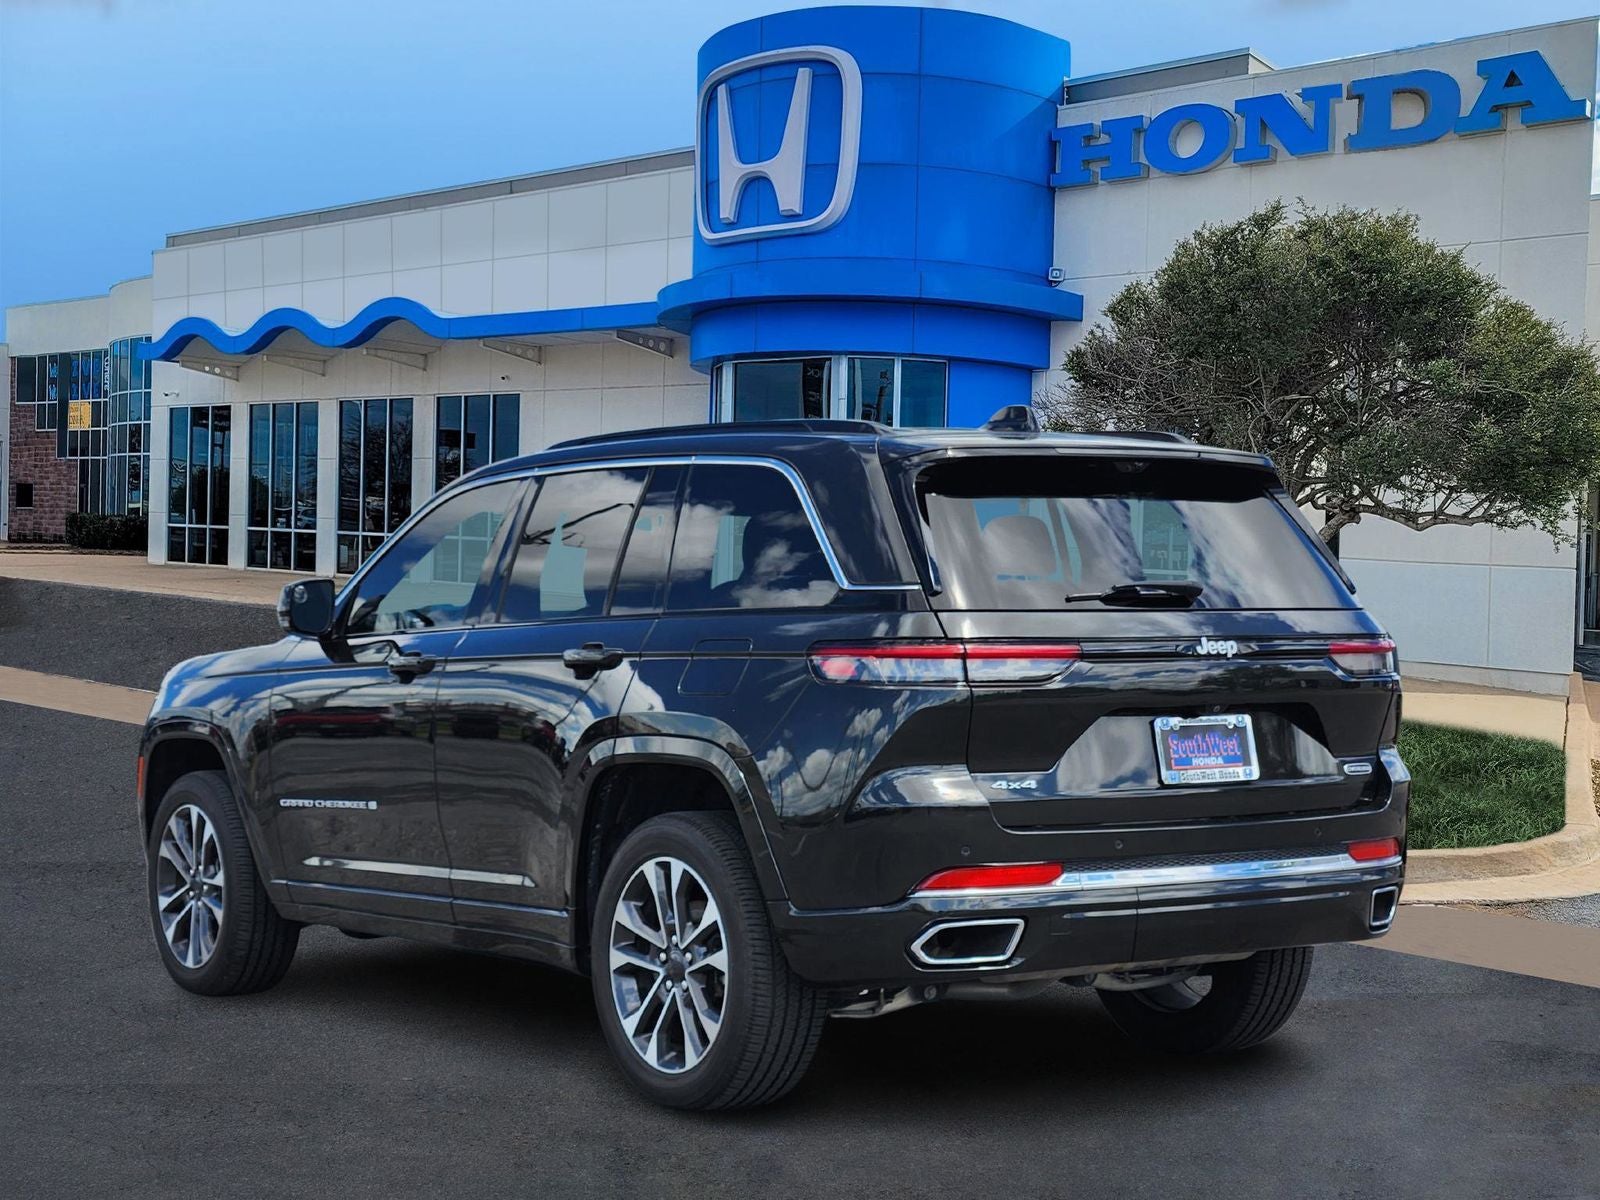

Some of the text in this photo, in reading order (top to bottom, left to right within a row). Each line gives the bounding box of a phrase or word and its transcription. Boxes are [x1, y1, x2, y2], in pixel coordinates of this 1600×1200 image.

[1050, 49, 1592, 188] HONDA
[1195, 636, 1238, 658] Jeep
[1191, 757, 1225, 767] HONDA
[991, 780, 1038, 790] 4x4
